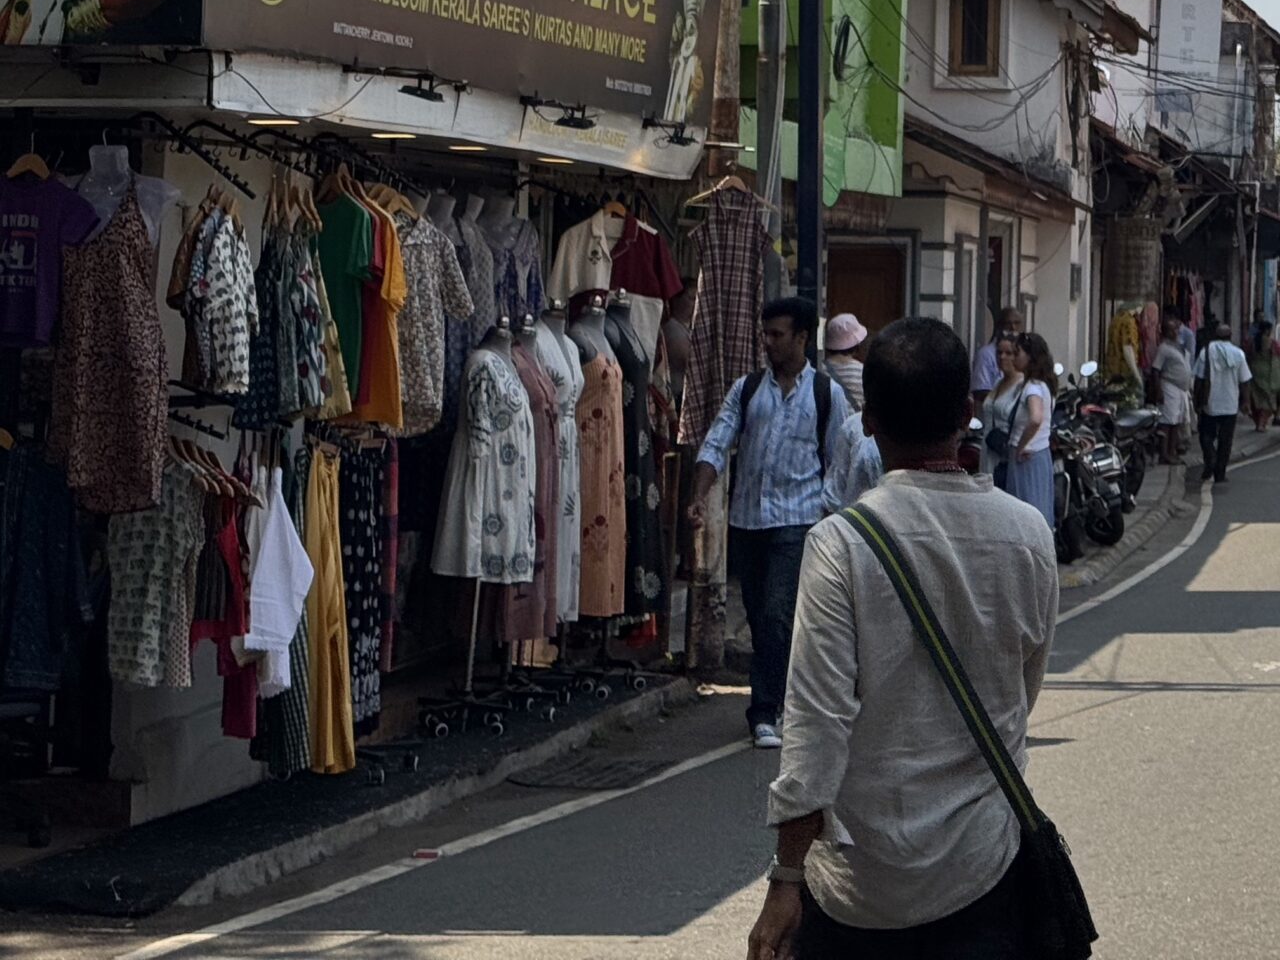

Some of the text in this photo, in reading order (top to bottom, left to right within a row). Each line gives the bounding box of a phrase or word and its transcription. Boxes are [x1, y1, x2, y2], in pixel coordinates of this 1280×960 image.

[482, 0, 531, 37] SAREE'S
[533, 12, 573, 47] KURTAS
[572, 24, 594, 51] AND
[594, 28, 621, 57] MANY
[620, 36, 647, 64] MORE
